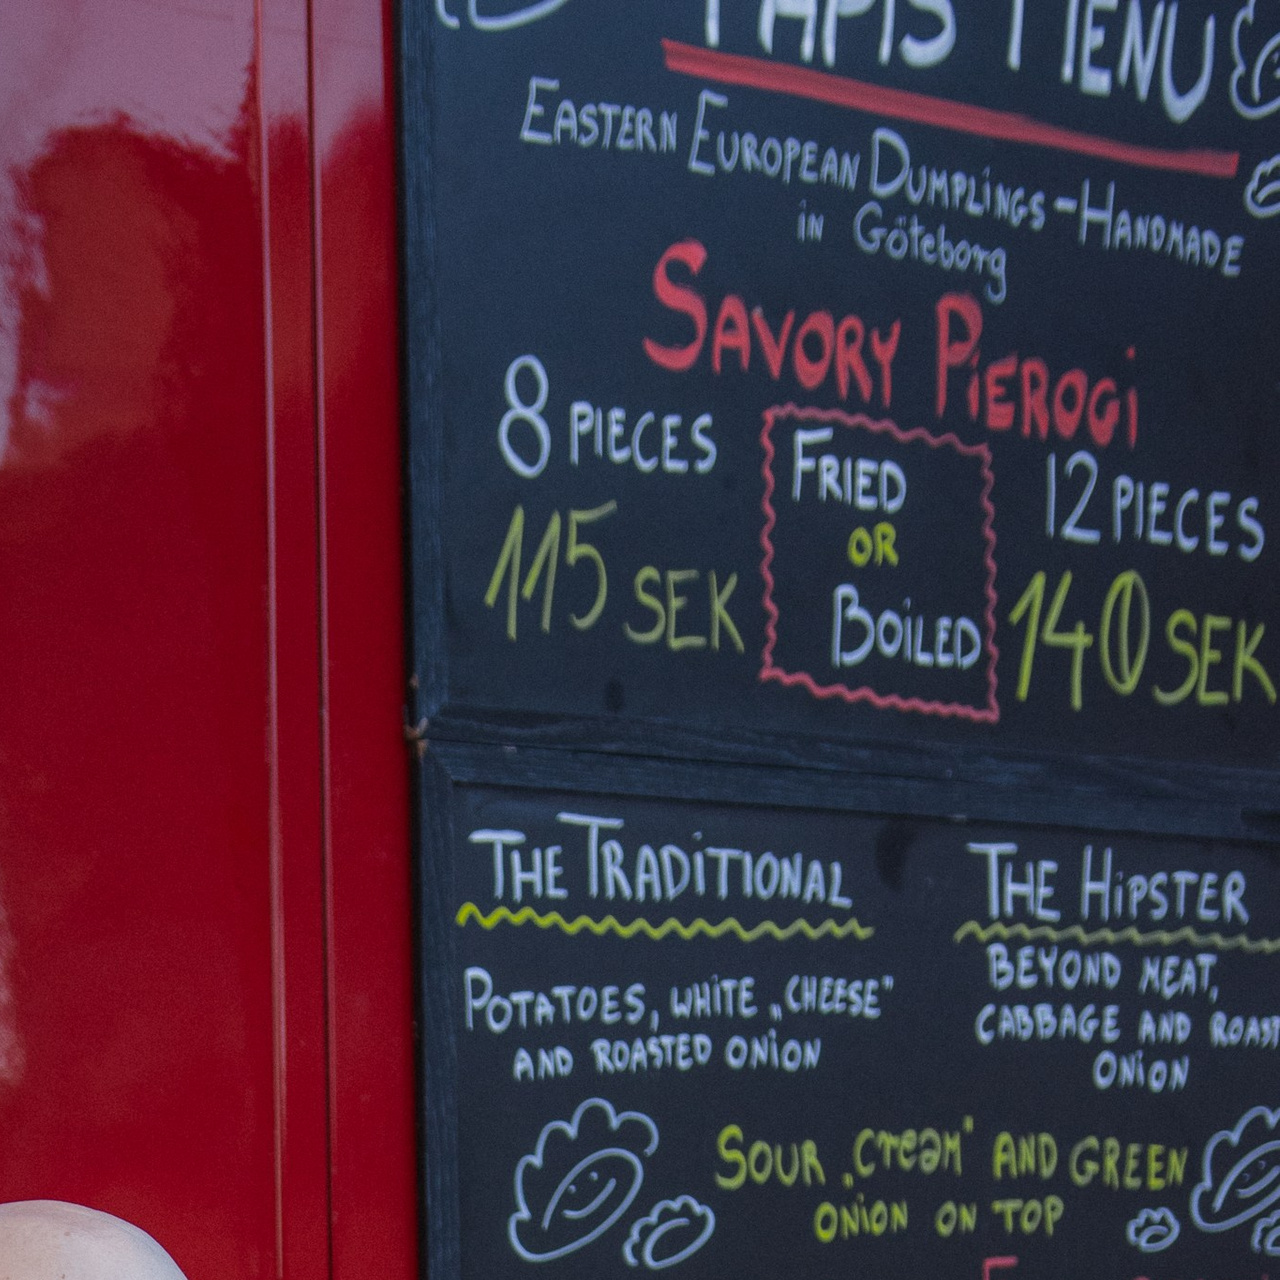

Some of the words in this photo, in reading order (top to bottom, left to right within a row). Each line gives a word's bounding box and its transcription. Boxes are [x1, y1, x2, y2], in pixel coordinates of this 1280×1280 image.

[853, 204, 1009, 304] Göteborg
[498, 354, 552, 478] 8
[568, 402, 719, 474] PIECES
[790, 426, 908, 512] FRIED
[1045, 450, 1101, 544] 12
[1113, 475, 1265, 562] PIECES
[485, 500, 618, 640] 115
[624, 568, 744, 654] SEK
[847, 522, 900, 568] OR
[1009, 569, 1151, 711] 140
[1154, 608, 1277, 706] SEK
[468, 829, 568, 901] THE
[966, 841, 1062, 922] THE
[988, 942, 1121, 990] BEYOND
[513, 1045, 575, 1082] AND
[590, 1032, 713, 1073] ROASTED
[975, 1003, 1121, 1045] CABBAGE
[1138, 1009, 1192, 1045] AND
[715, 1123, 826, 1191] SOUR
[992, 1130, 1059, 1181] AND
[1068, 1134, 1188, 1192] GREEN
[934, 1200, 978, 1237] ON
[991, 1194, 1064, 1237] TOP
